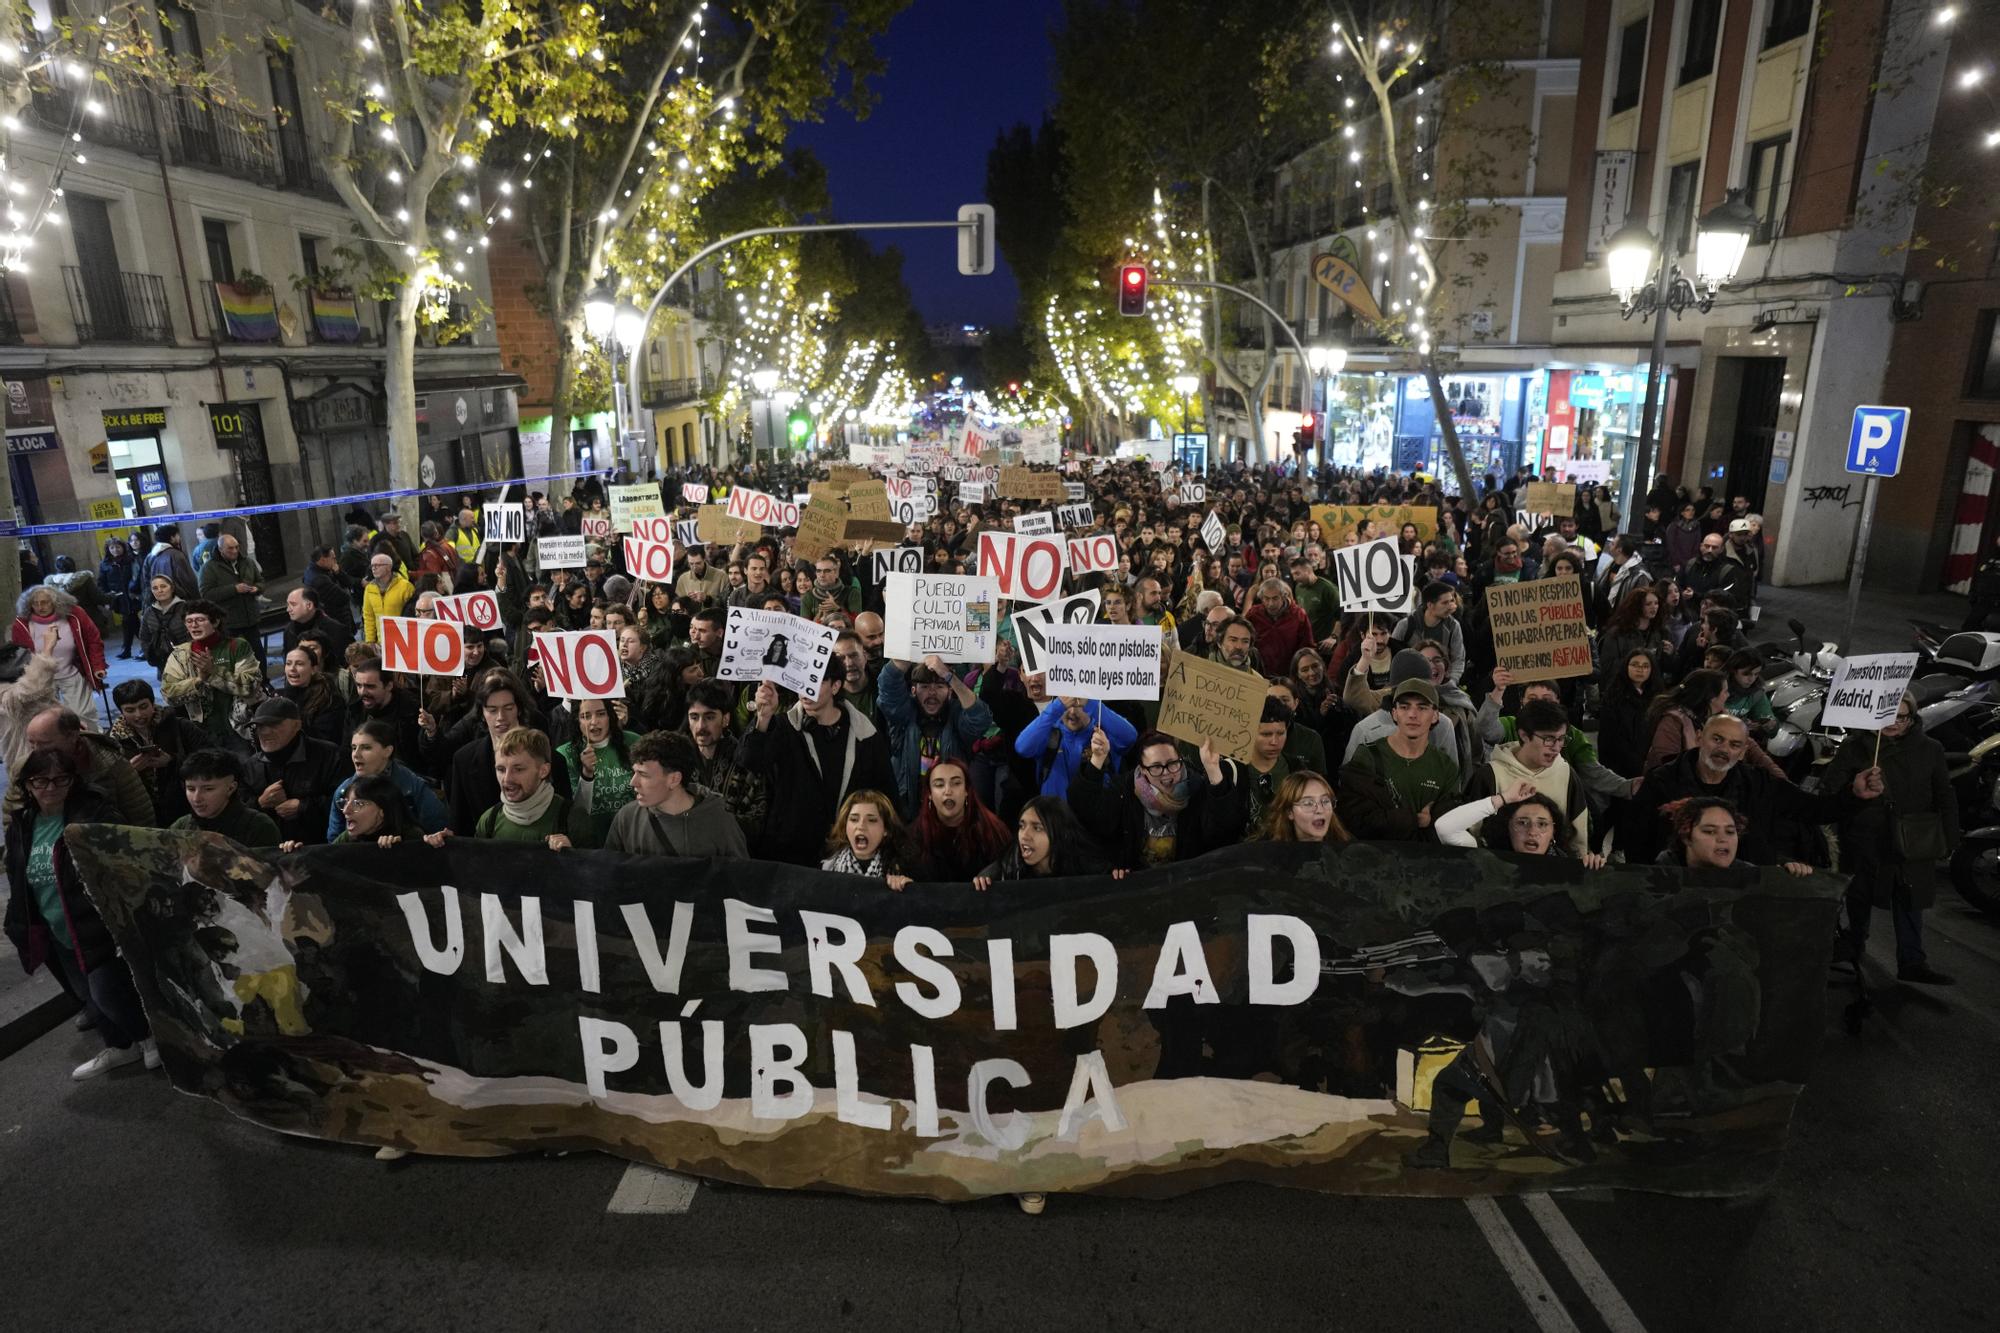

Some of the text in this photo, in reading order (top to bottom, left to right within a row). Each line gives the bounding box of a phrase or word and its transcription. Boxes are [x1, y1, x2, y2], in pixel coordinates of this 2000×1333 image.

[143, 412, 165, 424] FREE
[213, 414, 243, 433] 101
[16, 437, 47, 450] LOCA
[1856, 415, 1893, 466] P
[141, 471, 160, 482] ATM
[422, 465, 435, 481] Sky
[946, 467, 963, 480] NO
[1067, 462, 1080, 472] NO
[683, 484, 706, 502] NO
[888, 478, 912, 498] NO
[1182, 485, 1205, 501] NO
[729, 488, 770, 522] NO
[770, 504, 798, 525] NO
[1080, 507, 1092, 525] NO
[505, 510, 521, 541] NO
[583, 519, 608, 535] NO
[633, 518, 670, 544] NO
[1202, 513, 1223, 550] NO
[625, 538, 671, 580] NO
[876, 550, 920, 584] NO
[981, 535, 1061, 599] NO
[1070, 538, 1115, 573] NO
[1337, 541, 1399, 601] NO
[916, 579, 966, 597] PUEBLO
[1491, 581, 1579, 608] SI NO HAY RESPIRO
[436, 593, 498, 629] NO
[747, 611, 786, 625] Alumna
[1493, 612, 1519, 628] PARA
[1521, 609, 1537, 624] LAS
[914, 617, 960, 631] PRIVADA
[1495, 622, 1587, 649] NO HABRÁ PAZ PARA
[383, 618, 462, 673] NO
[721, 610, 743, 676] AYUSO
[921, 635, 964, 652] INSULTO
[1049, 636, 1159, 661] Unos, sólo con pistolas;
[536, 634, 618, 695] NO
[806, 631, 834, 697] ABUSO
[1169, 662, 1186, 685] A
[1500, 653, 1535, 672] QUIENES
[1535, 652, 1552, 668] NOS
[1844, 661, 1883, 682] Inversión
[1049, 664, 1157, 690] otros, con leyes roban.
[1167, 687, 1250, 728] VAN NUESTRAS
[1830, 687, 1873, 713] Madrid,
[396, 885, 1322, 1030] UNIVERSIDAD
[578, 999, 1128, 1151] PÚBLICA
